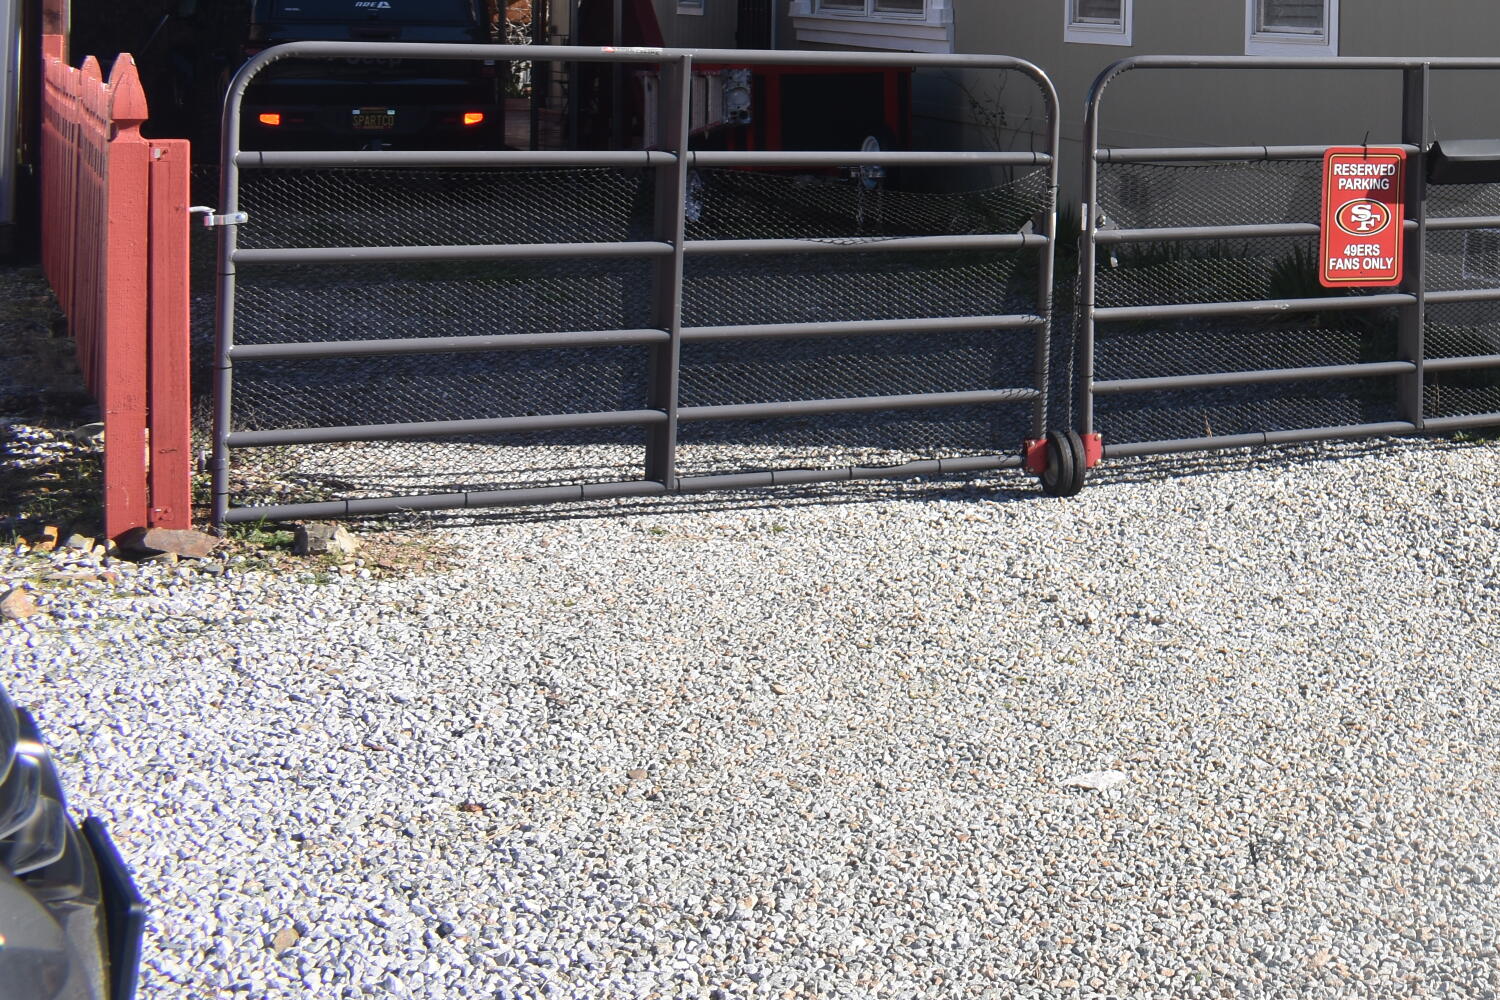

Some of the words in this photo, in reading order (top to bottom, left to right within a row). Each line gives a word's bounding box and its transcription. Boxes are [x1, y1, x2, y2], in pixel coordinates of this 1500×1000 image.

[1333, 163, 1396, 176] RESERVED
[1338, 177, 1390, 190] PARKING
[1350, 204, 1381, 231] SF
[1343, 244, 1380, 257] 49ERS
[1329, 258, 1360, 270] FANS
[1362, 257, 1394, 270] ONLY
